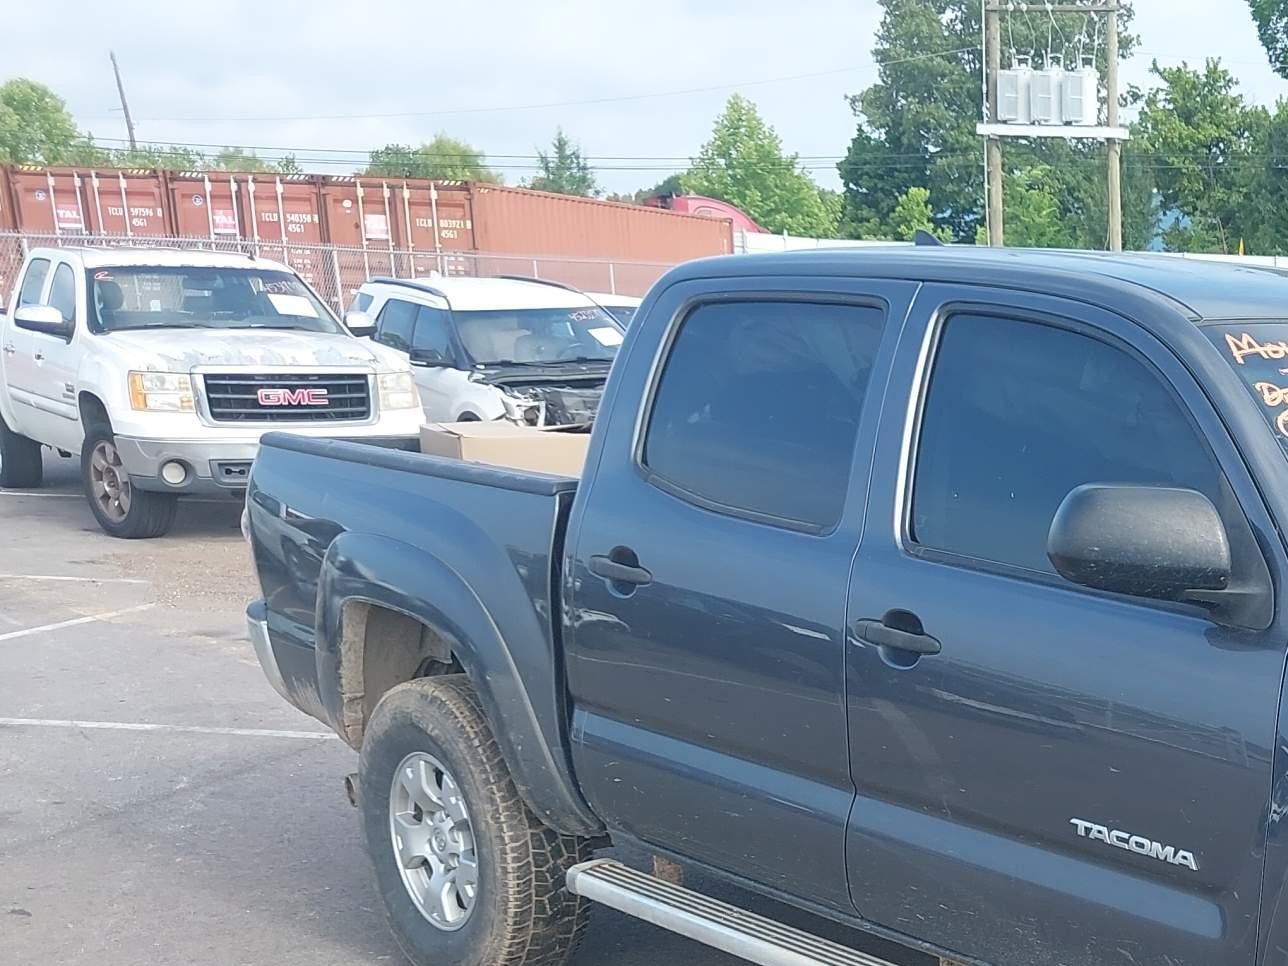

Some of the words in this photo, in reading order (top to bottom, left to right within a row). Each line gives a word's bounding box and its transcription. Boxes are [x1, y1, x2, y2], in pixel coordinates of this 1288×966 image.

[57, 209, 80, 218] TAL
[213, 214, 236, 224] TAL
[257, 389, 329, 405] GMC
[1069, 817, 1199, 871] TACOMA
